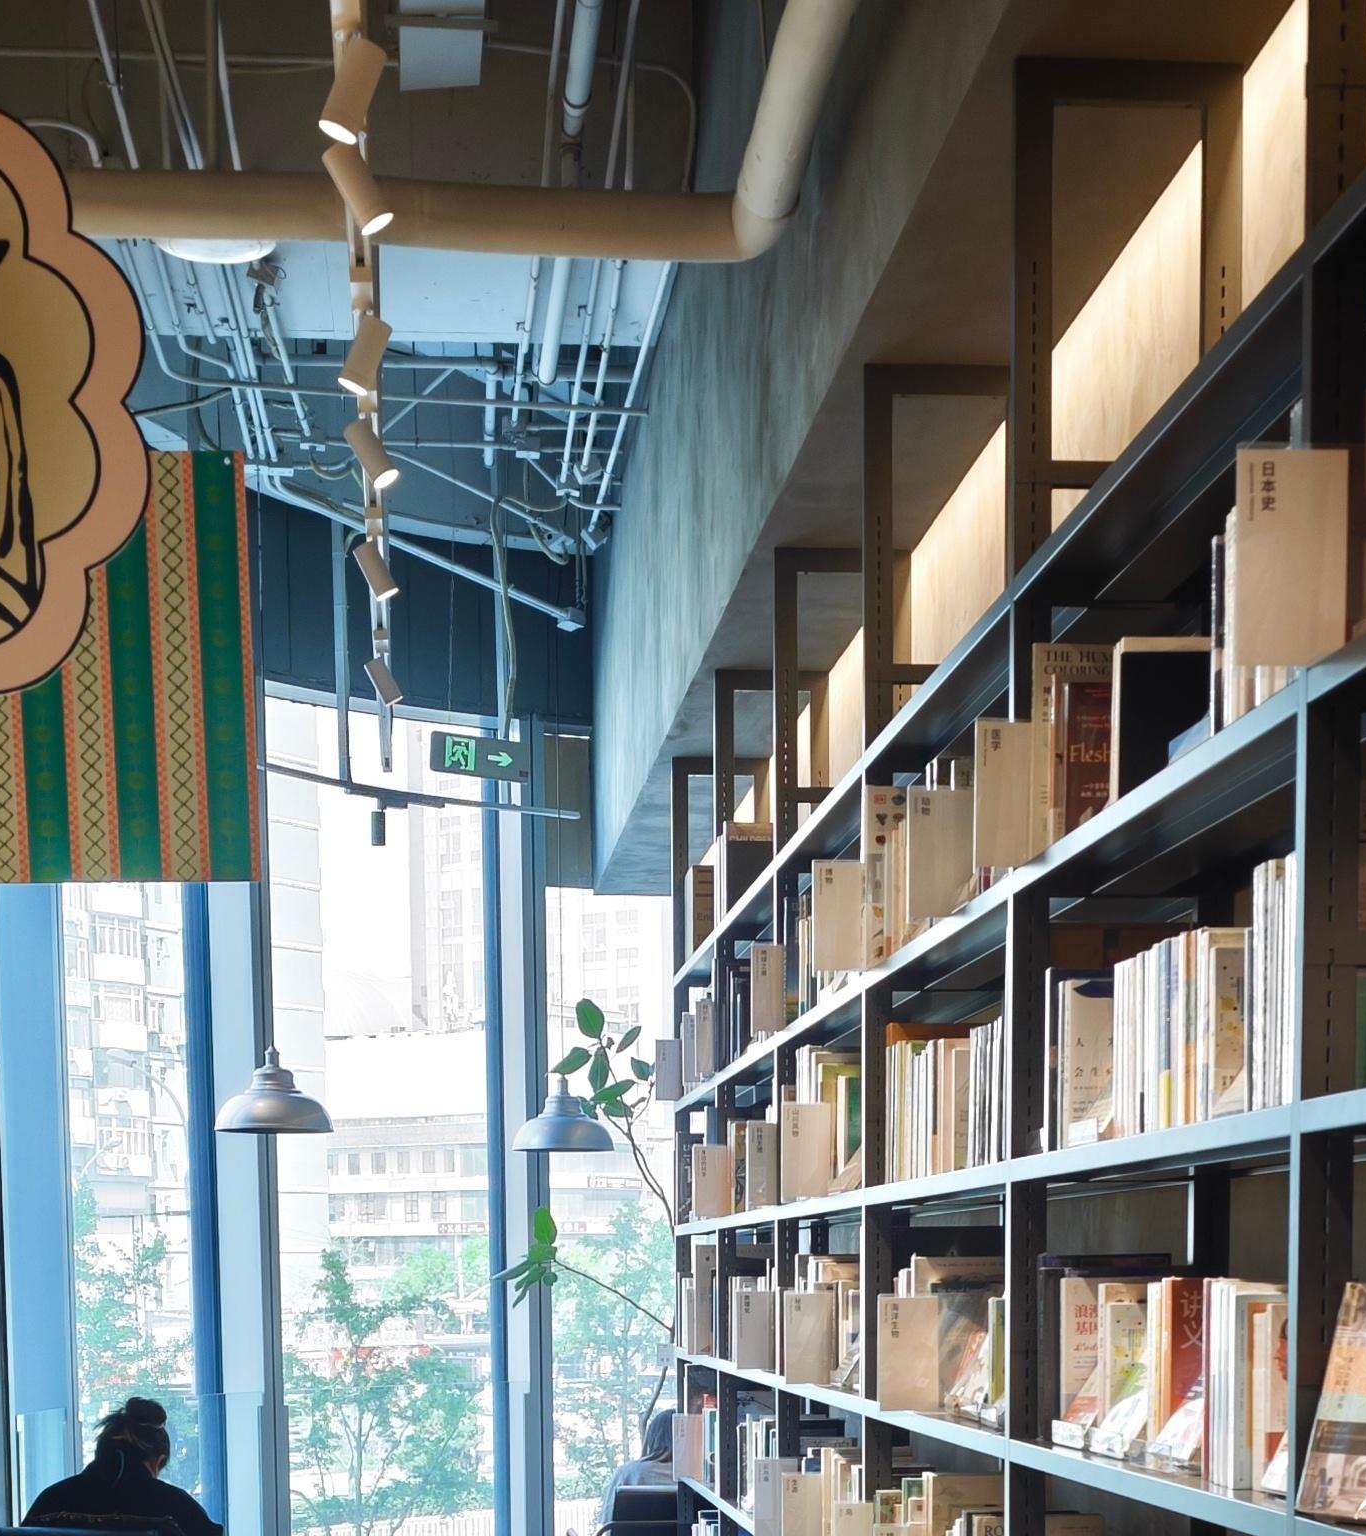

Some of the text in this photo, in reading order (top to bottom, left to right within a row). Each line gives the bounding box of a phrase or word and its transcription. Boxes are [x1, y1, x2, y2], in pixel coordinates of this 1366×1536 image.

[1260, 461, 1276, 512] 日本史
[1044, 651, 1073, 663] THE
[990, 728, 1002, 751] 医学
[1069, 744, 1111, 764] Flesh
[890, 1302, 901, 1339] 海洋生物
